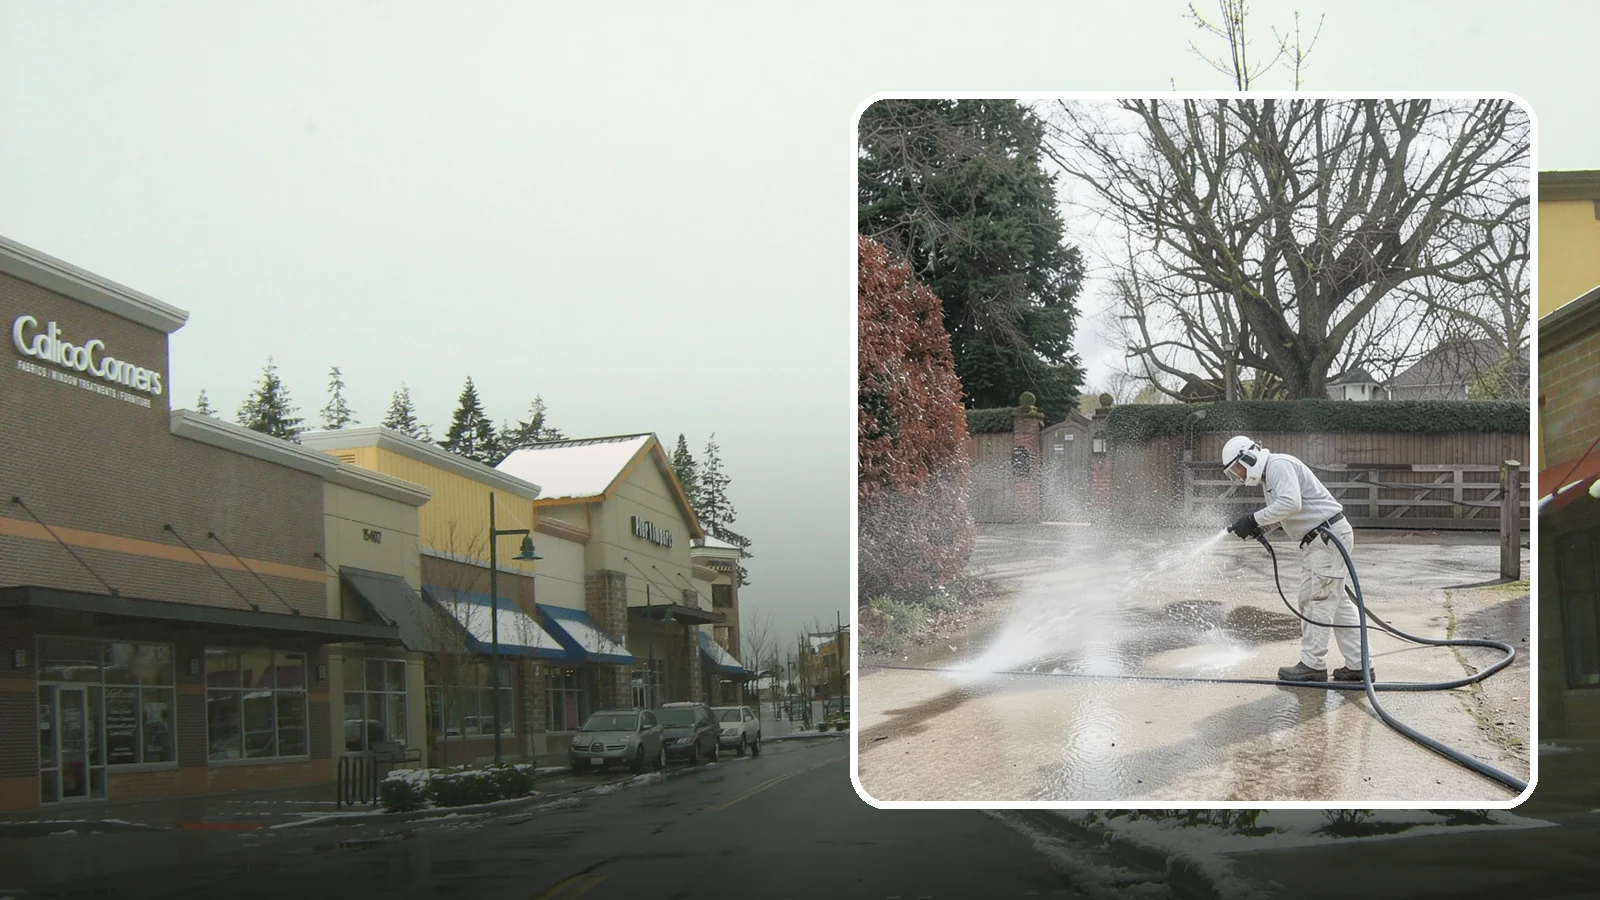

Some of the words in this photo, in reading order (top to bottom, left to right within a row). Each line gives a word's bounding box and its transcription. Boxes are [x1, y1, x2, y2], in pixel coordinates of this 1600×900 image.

[17, 359, 47, 377] FABRICS
[51, 369, 78, 387] WINDOW
[78, 378, 116, 399] TREATMENTS
[120, 390, 151, 409] FURNITURE
